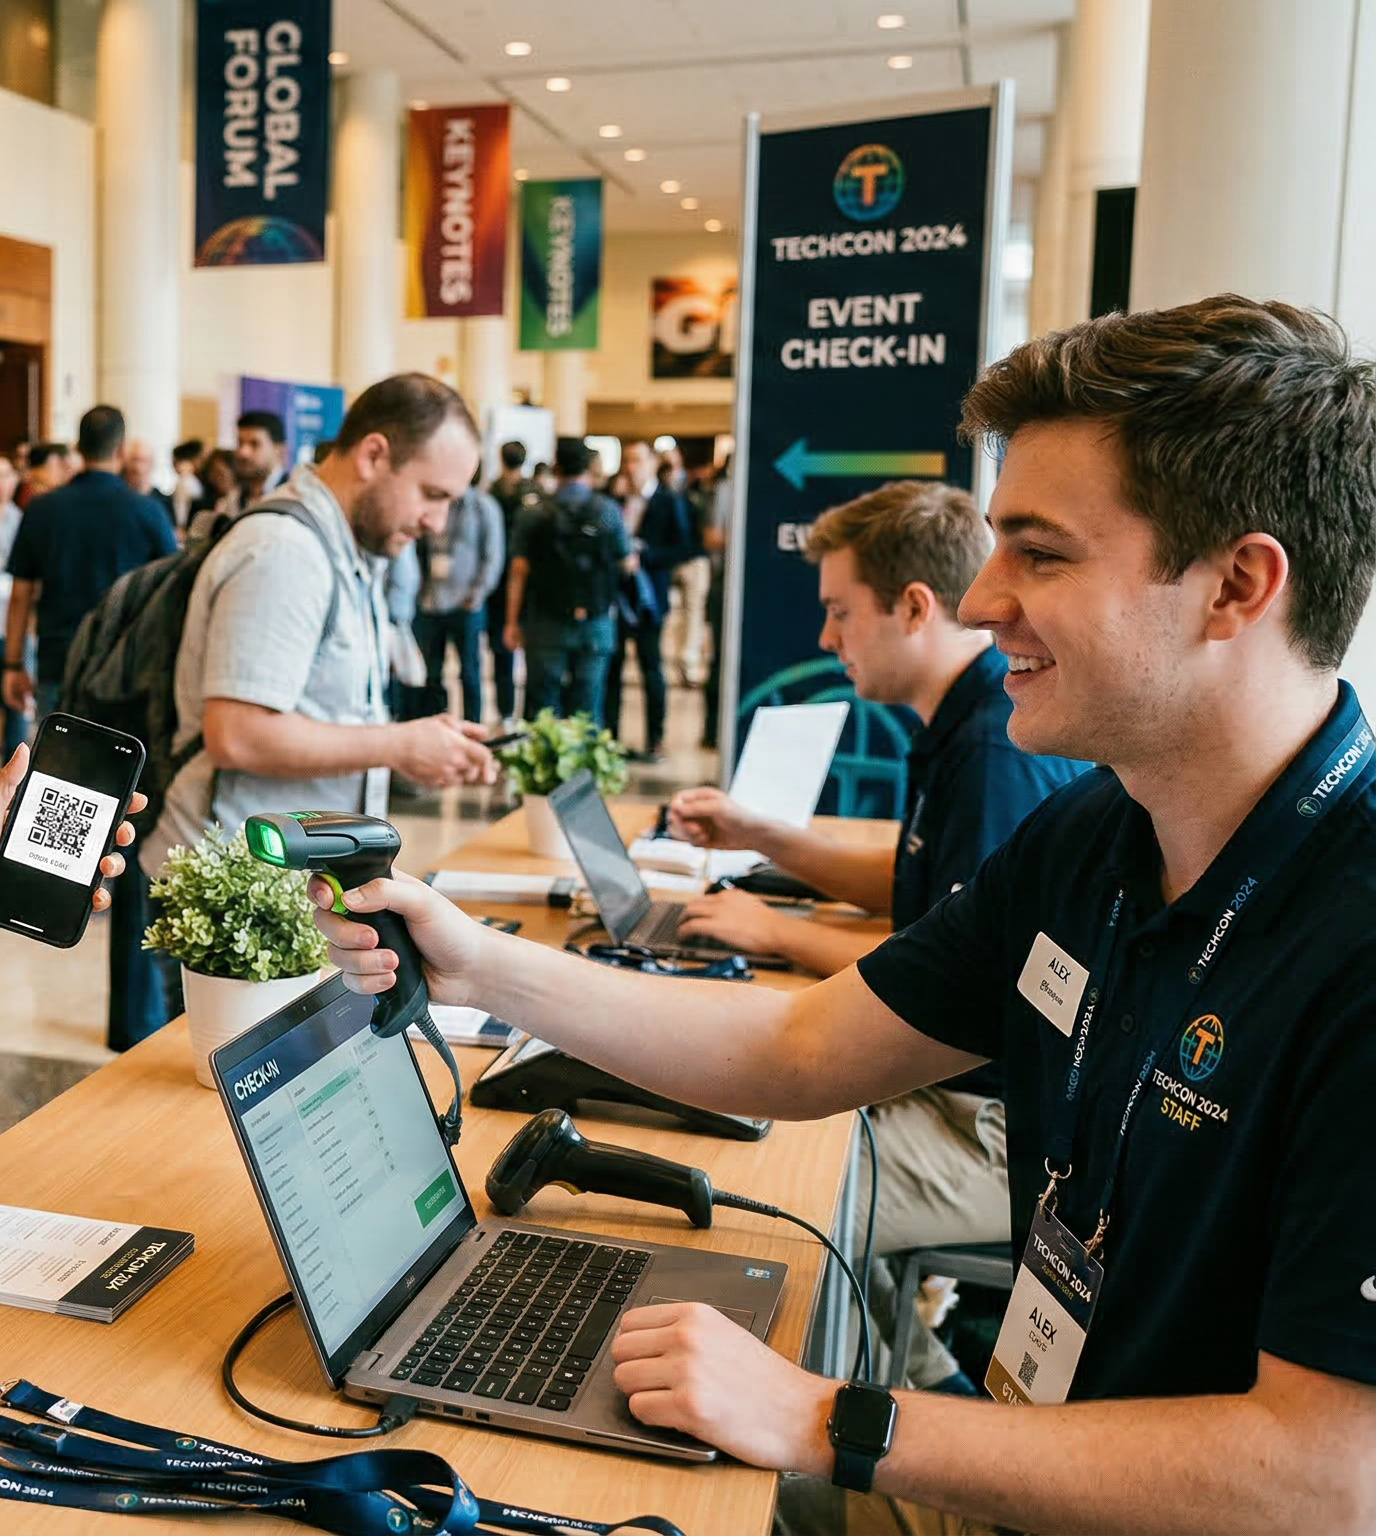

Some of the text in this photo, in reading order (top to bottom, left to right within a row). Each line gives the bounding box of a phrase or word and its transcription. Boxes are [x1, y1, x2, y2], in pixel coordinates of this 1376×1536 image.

[224, 28, 259, 188] FORUM
[264, 20, 303, 200] GLOBAL
[771, 223, 968, 262] TECHCON 2024
[808, 293, 922, 329] EVENT
[780, 333, 946, 370] CHECK-IN
[1197, 876, 1259, 968] TECHCON 2024
[1048, 957, 1071, 985] ALEX
[1152, 1068, 1229, 1123] TECHCON 2024
[1160, 1096, 1202, 1132] STAFF
